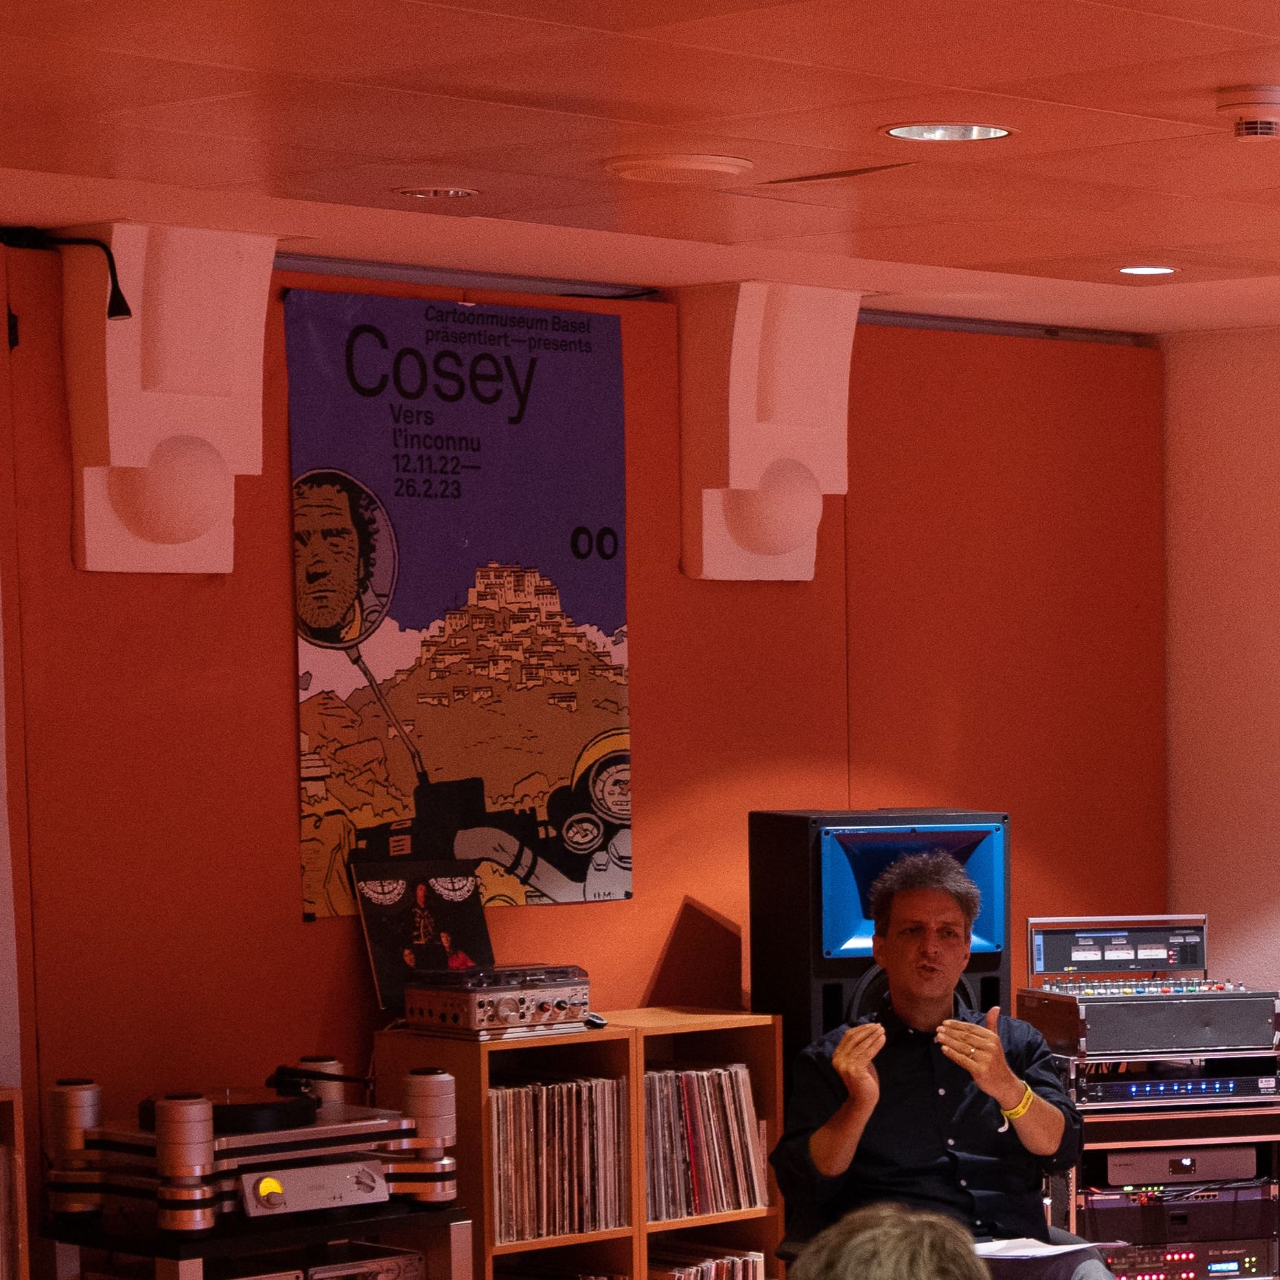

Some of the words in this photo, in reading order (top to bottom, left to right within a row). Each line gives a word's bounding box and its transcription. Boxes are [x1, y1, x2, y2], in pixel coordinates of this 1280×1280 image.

[424, 305, 549, 330] Cartoonmuseum
[551, 315, 591, 334] Basel
[345, 323, 538, 425] Cosey
[389, 404, 434, 426] Vers
[392, 429, 481, 452] l'inconnu
[394, 478, 461, 499] 26.2.23
